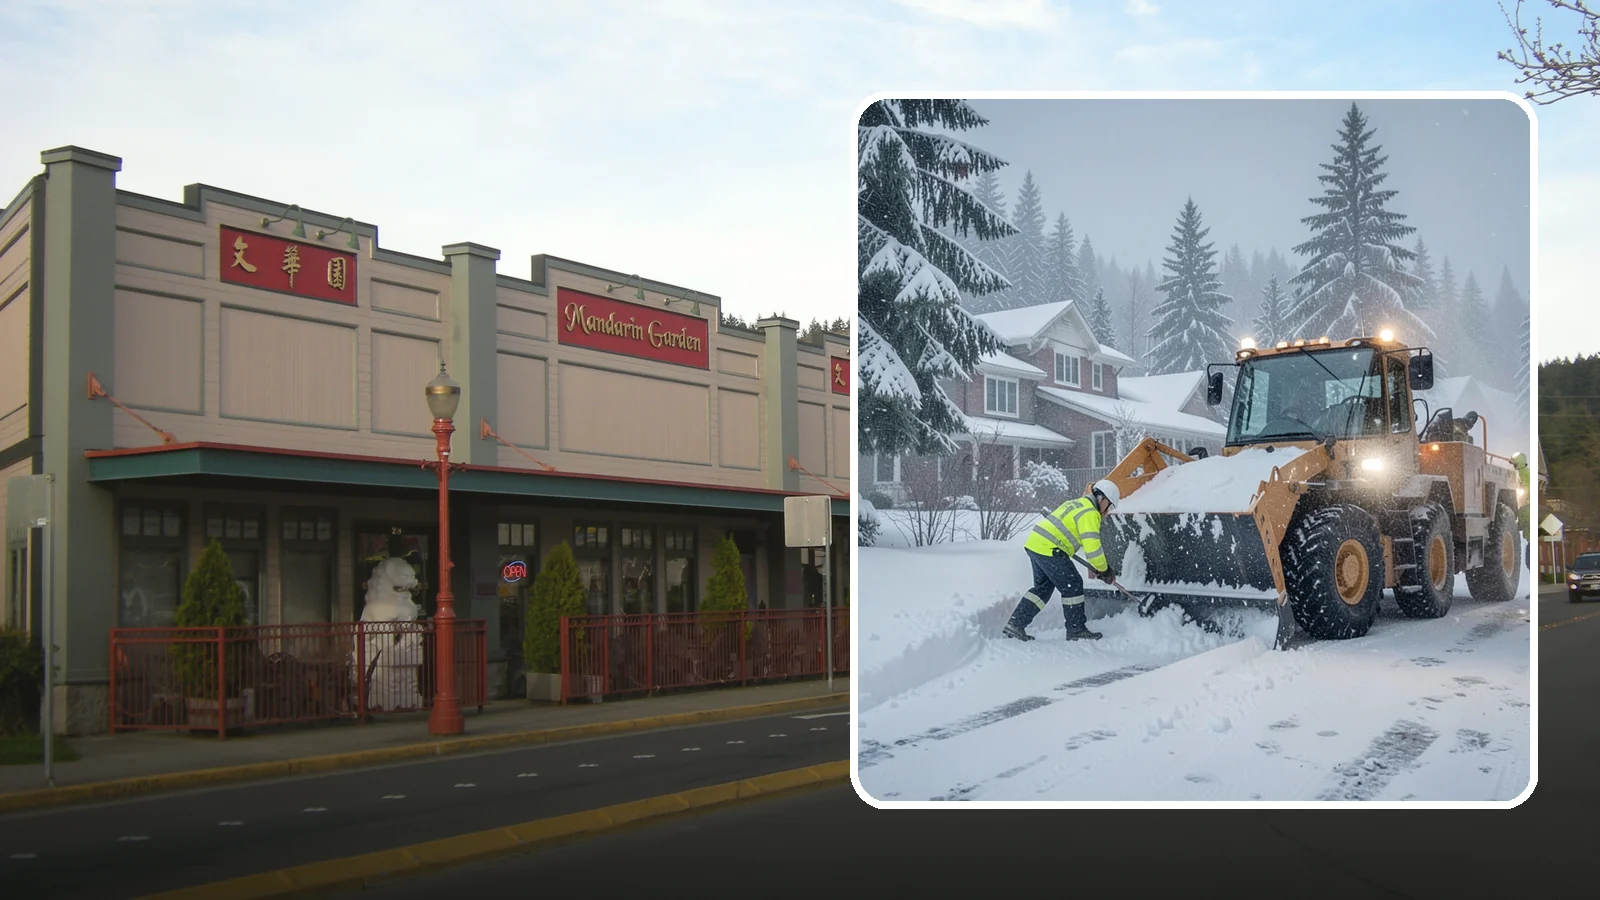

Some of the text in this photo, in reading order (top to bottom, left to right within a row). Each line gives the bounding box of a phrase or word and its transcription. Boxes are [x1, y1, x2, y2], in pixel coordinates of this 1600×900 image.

[231, 236, 346, 291] 文華園
[564, 302, 702, 352] Mandarin Garden
[503, 565, 527, 578] OPEN
